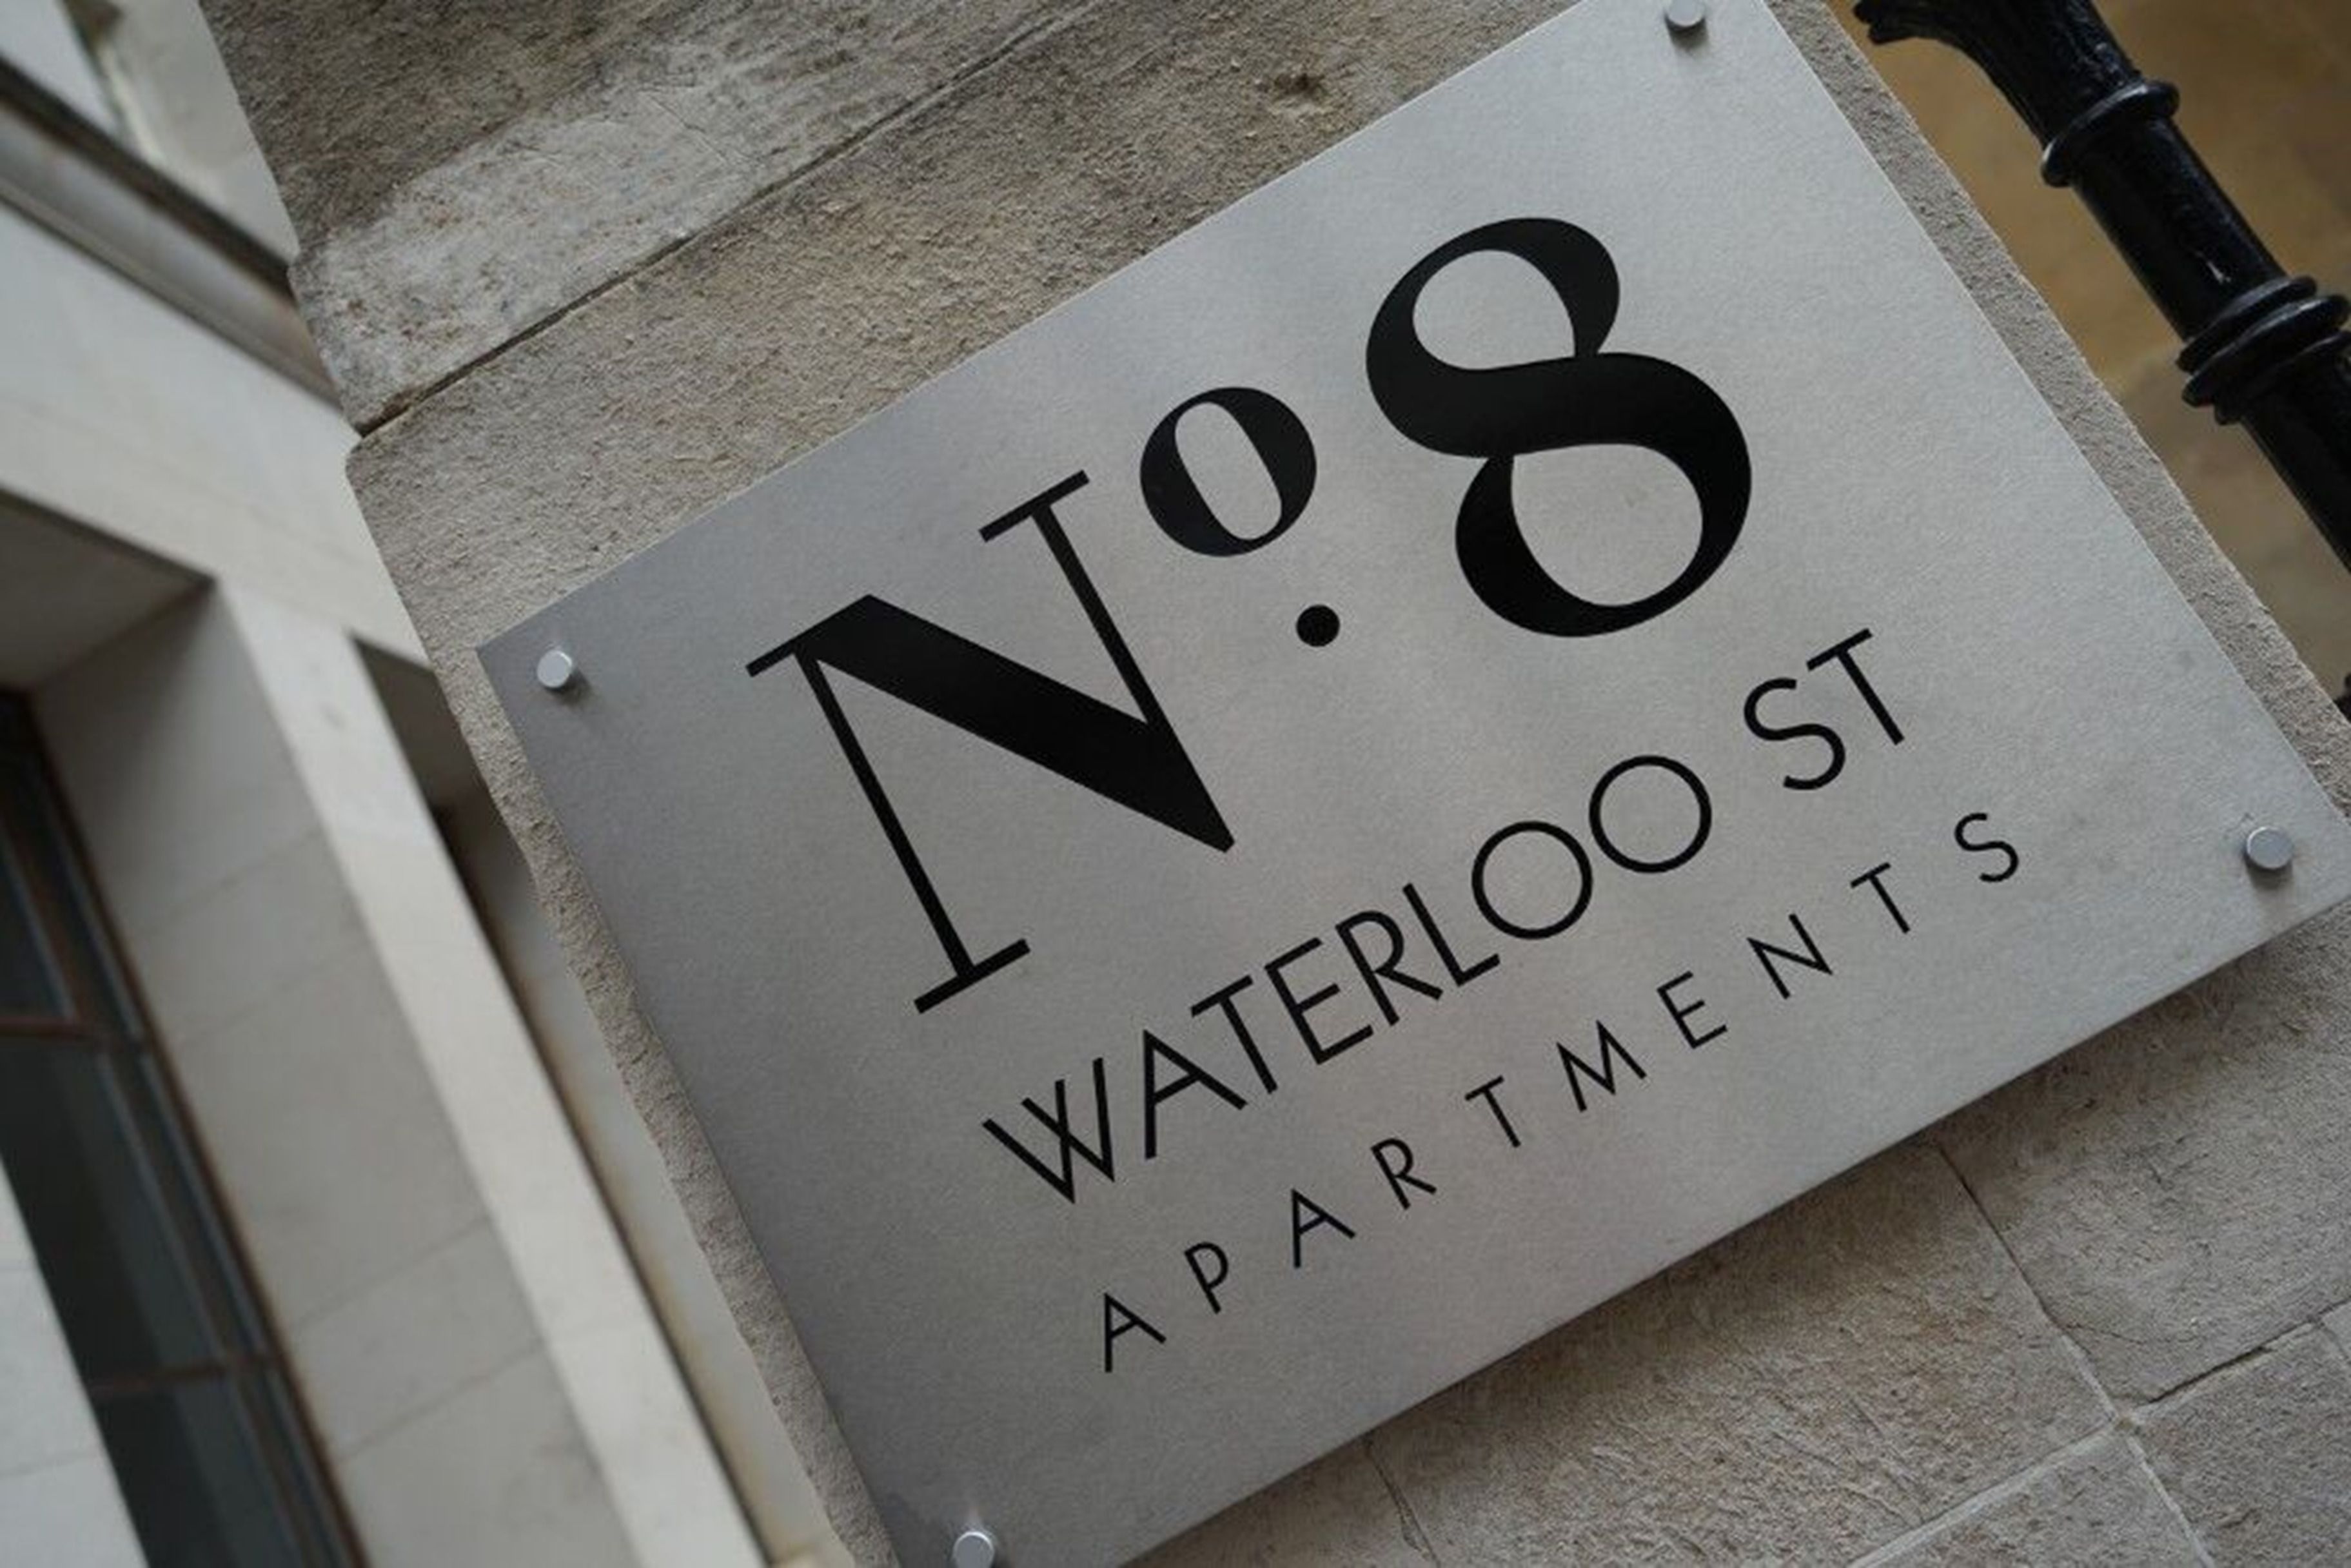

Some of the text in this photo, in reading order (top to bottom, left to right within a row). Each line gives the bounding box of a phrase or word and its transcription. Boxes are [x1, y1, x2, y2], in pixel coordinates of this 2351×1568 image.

[982, 629, 1903, 1204] WATERLOO ST
[1103, 813, 2018, 1373] APARTMENTS
